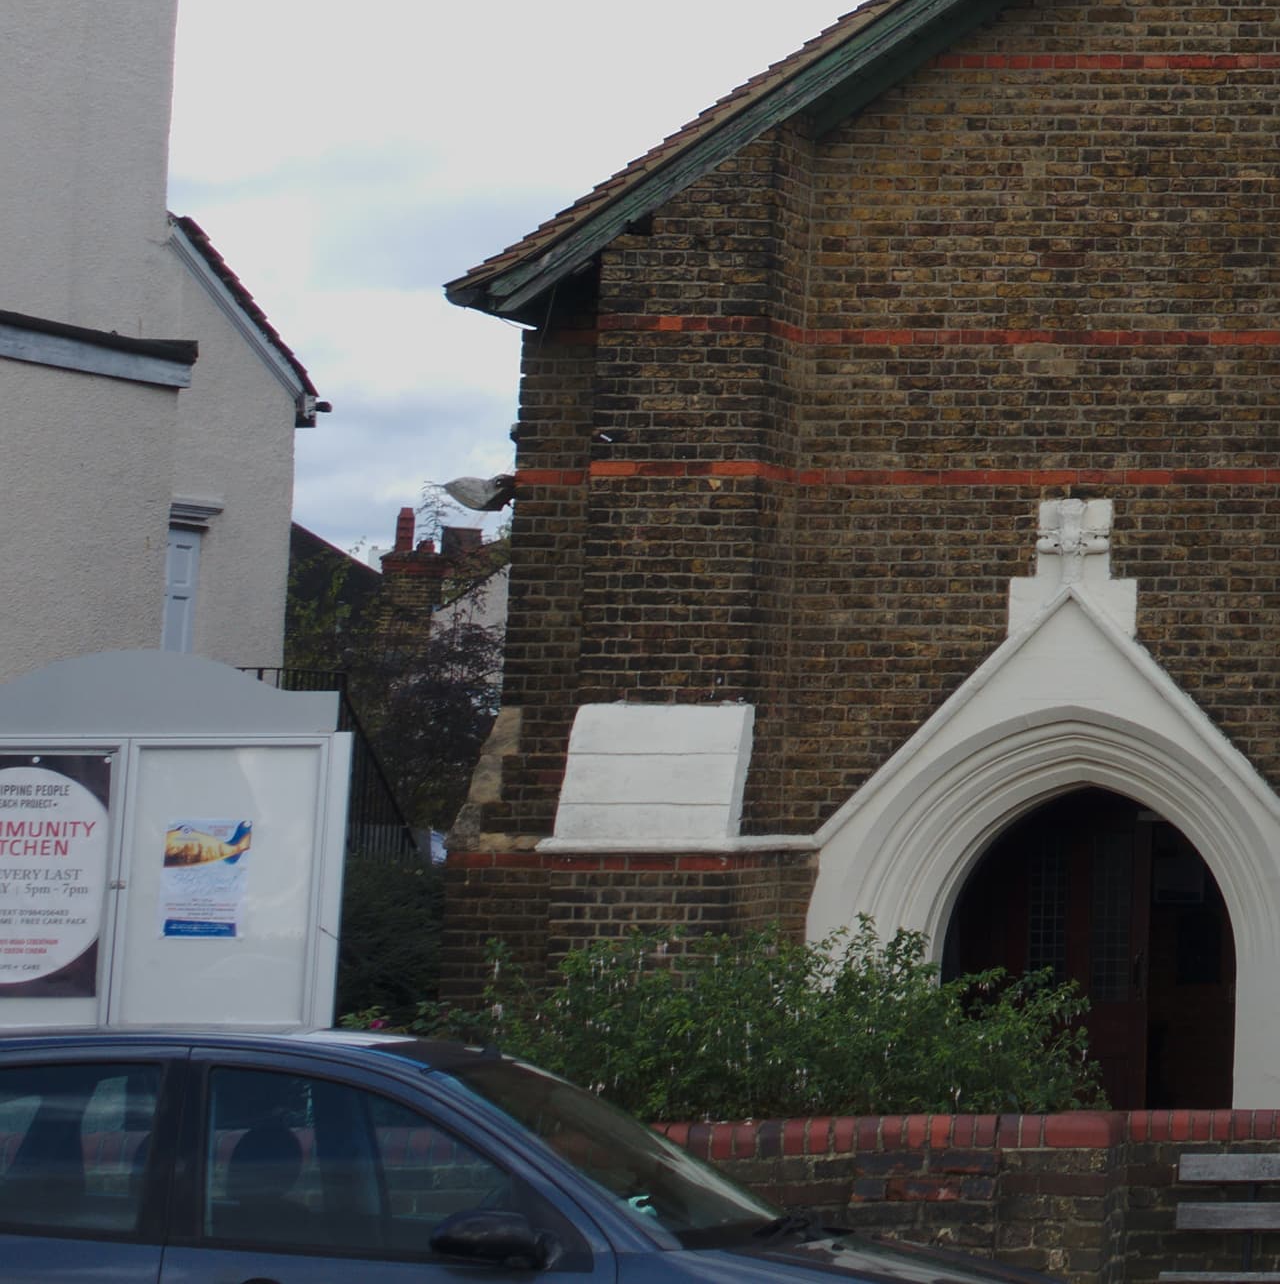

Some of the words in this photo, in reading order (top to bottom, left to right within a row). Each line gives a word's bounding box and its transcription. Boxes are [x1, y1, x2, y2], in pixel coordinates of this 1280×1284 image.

[35, 784, 71, 796] PEOPLE
[0, 821, 97, 837] MUNITY
[44, 869, 83, 881] LAST
[24, 883, 51, 897] 5pm
[62, 883, 88, 897] 7pm
